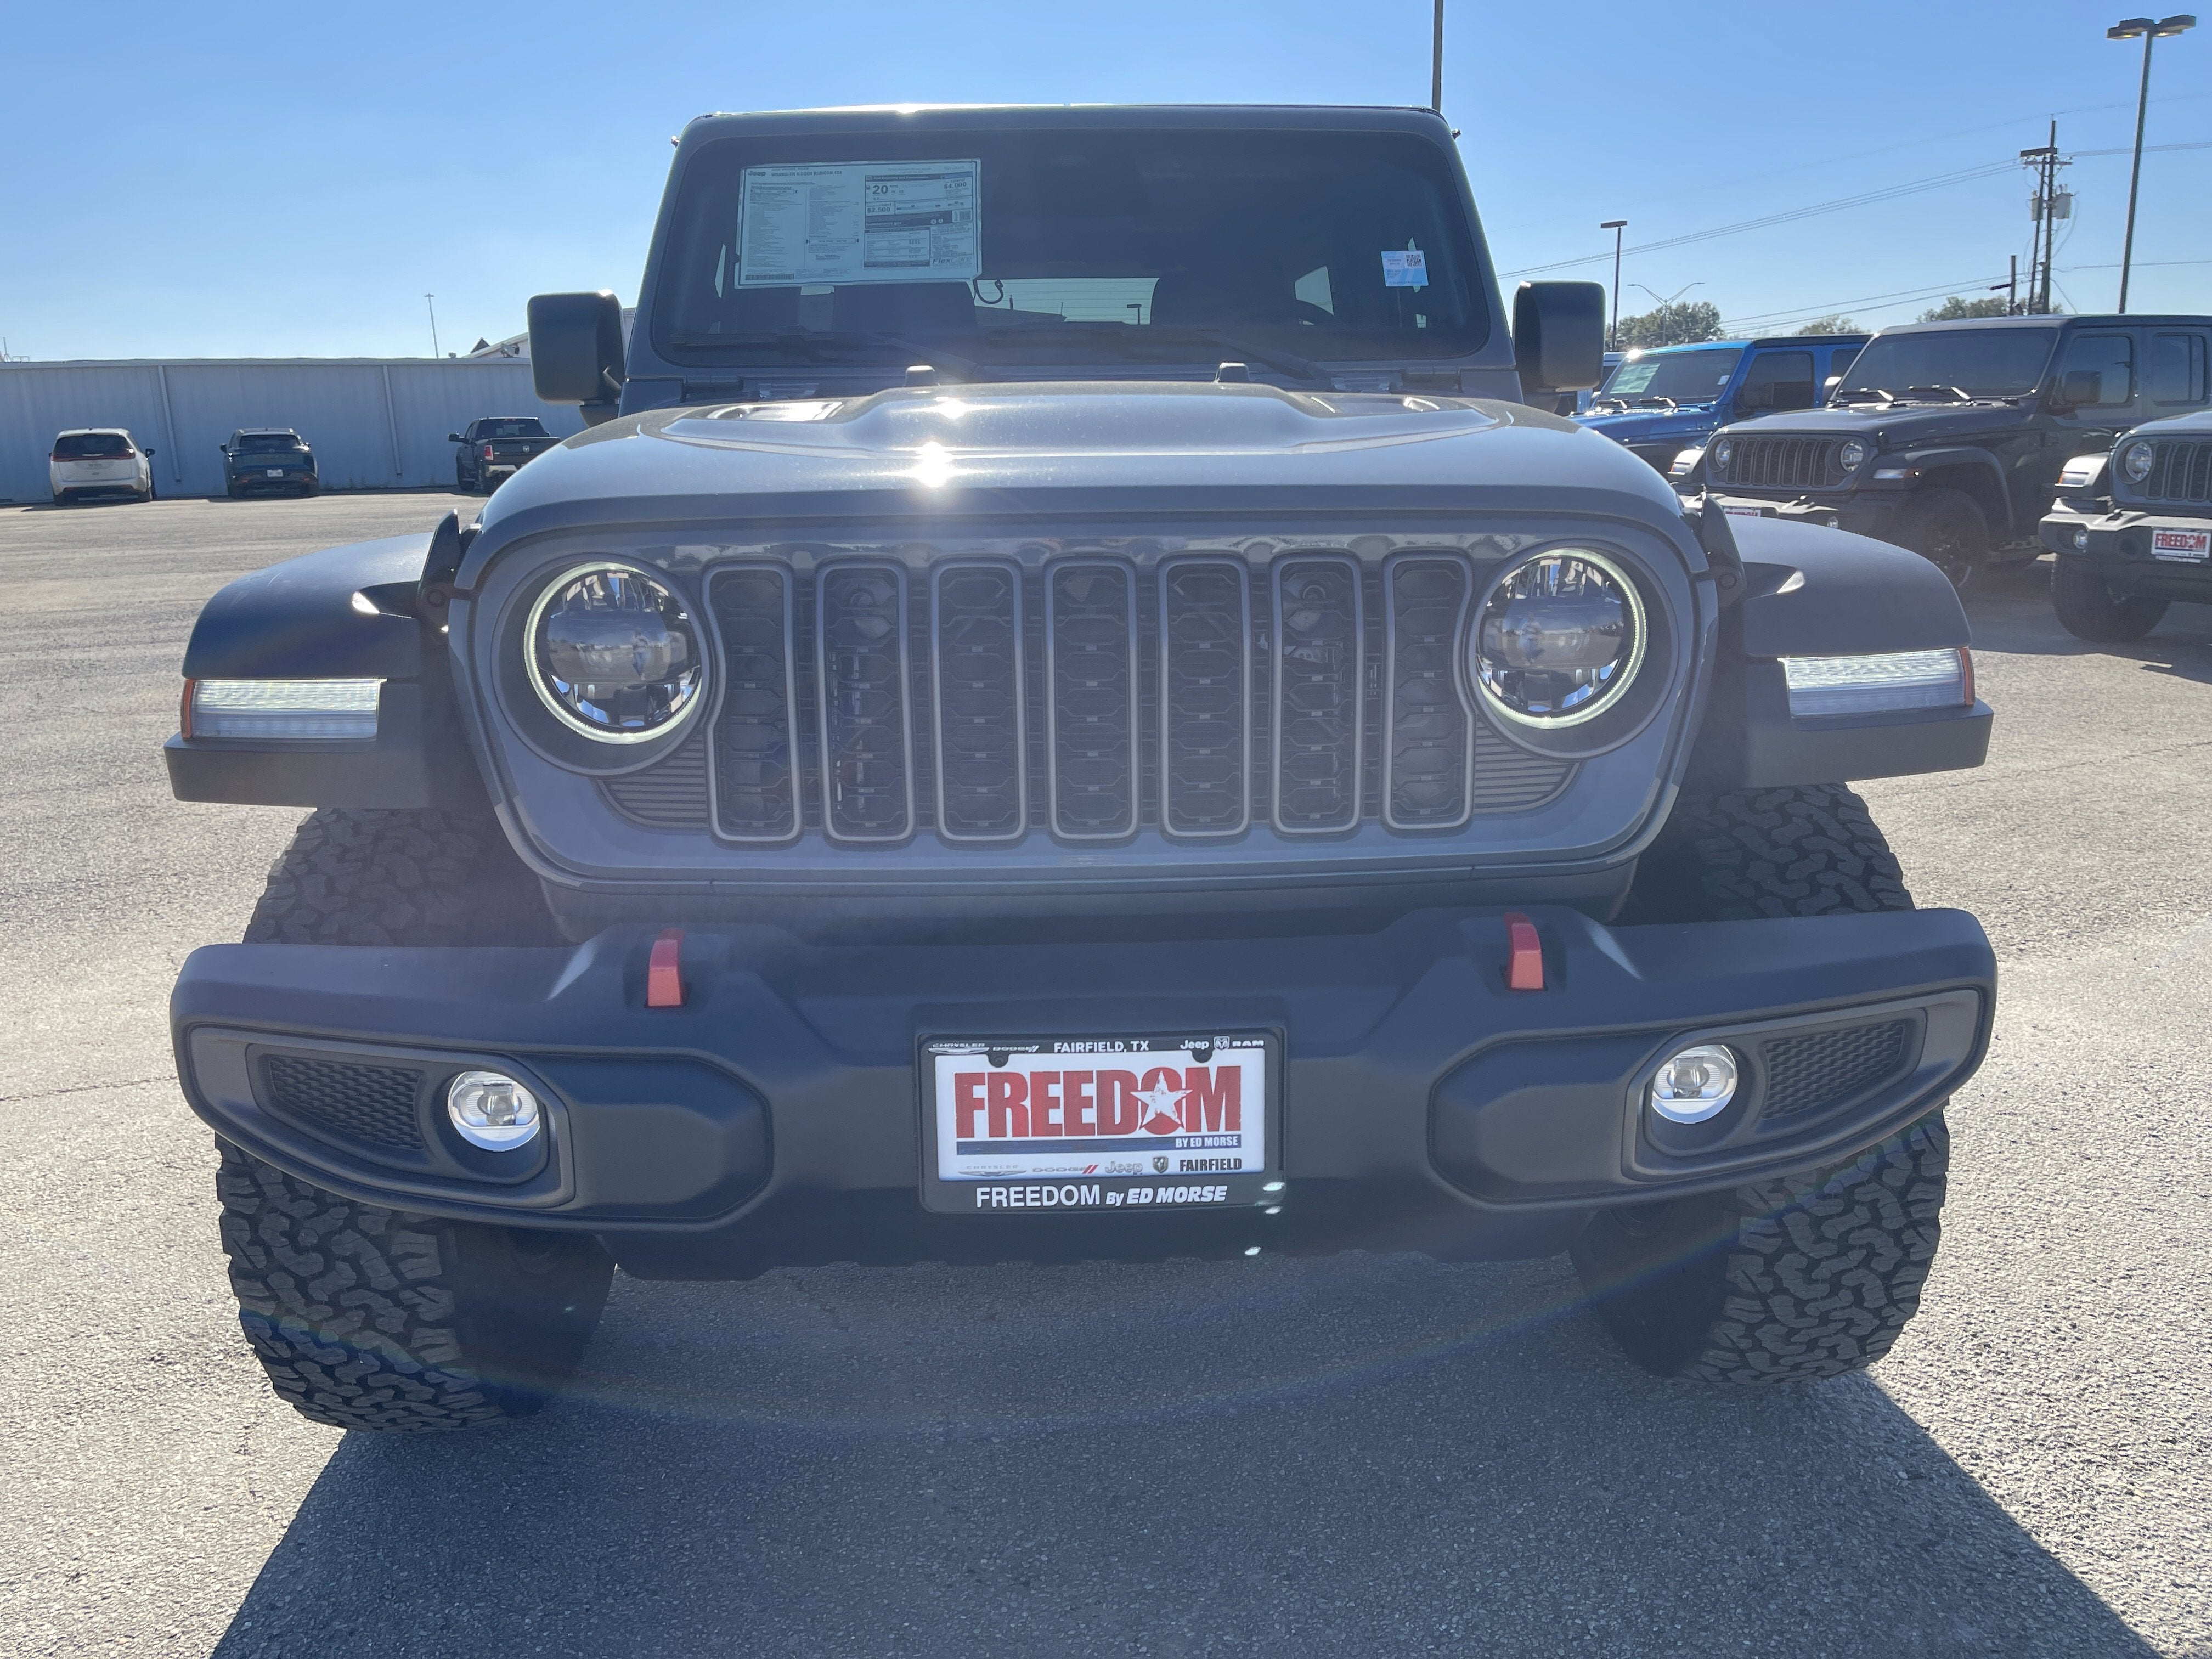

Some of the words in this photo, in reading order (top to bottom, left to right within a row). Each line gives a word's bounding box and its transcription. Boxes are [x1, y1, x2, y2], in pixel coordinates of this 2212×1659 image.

[872, 184, 888, 195] 20
[2155, 534, 2207, 549] FREEDOM
[1053, 1041, 1127, 1053] FAIRFIELD,
[1130, 1040, 1150, 1052] TX
[1180, 1040, 1210, 1051] Jeep
[954, 1065, 1242, 1138] FREEDOM
[1175, 1139, 1189, 1148] BY
[1190, 1138, 1202, 1148] ED
[1204, 1136, 1238, 1147] MORSE
[1105, 1161, 1143, 1175] Jeep
[1179, 1158, 1242, 1172] FAIRFIELD
[976, 1184, 1101, 1208] FREEDOM
[1105, 1192, 1125, 1206] By
[1127, 1188, 1153, 1204] ED
[1156, 1185, 1228, 1203] MORSE
